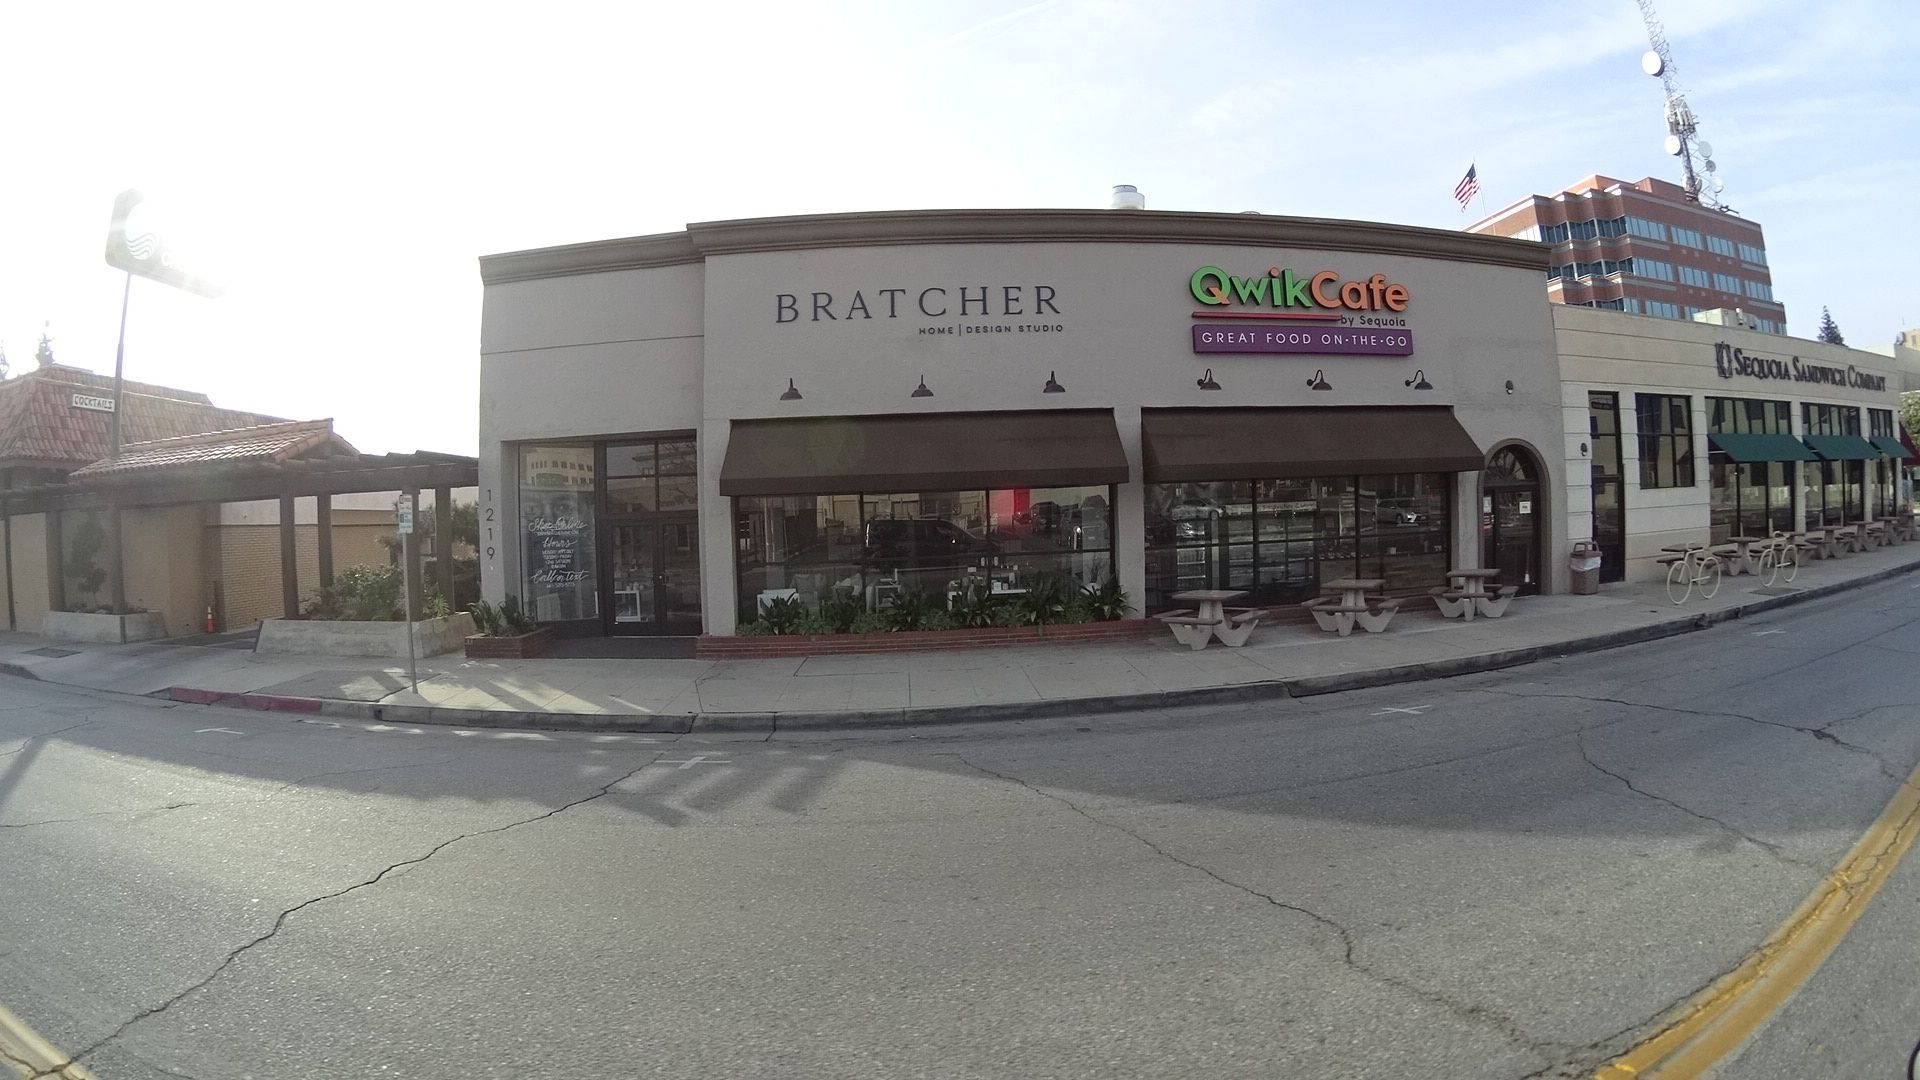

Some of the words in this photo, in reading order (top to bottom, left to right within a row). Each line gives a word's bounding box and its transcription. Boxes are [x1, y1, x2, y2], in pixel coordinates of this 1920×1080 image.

[1190, 265, 1410, 312] QwikCafe
[775, 285, 1061, 323] BRATCHER
[1340, 314, 1355, 327] by
[1360, 315, 1406, 327] Sequoia
[918, 326, 954, 335] HOME
[965, 325, 1012, 334] DESIGN
[1017, 324, 1064, 333] STUDIO
[1201, 332, 1256, 343] GREAT
[1266, 333, 1311, 344] FOOD
[1734, 348, 1791, 380] SEQUOIA
[1792, 355, 1847, 387] SANDWICH
[1848, 363, 1887, 392] COMPANY
[75, 396, 112, 409] COCKTAILS
